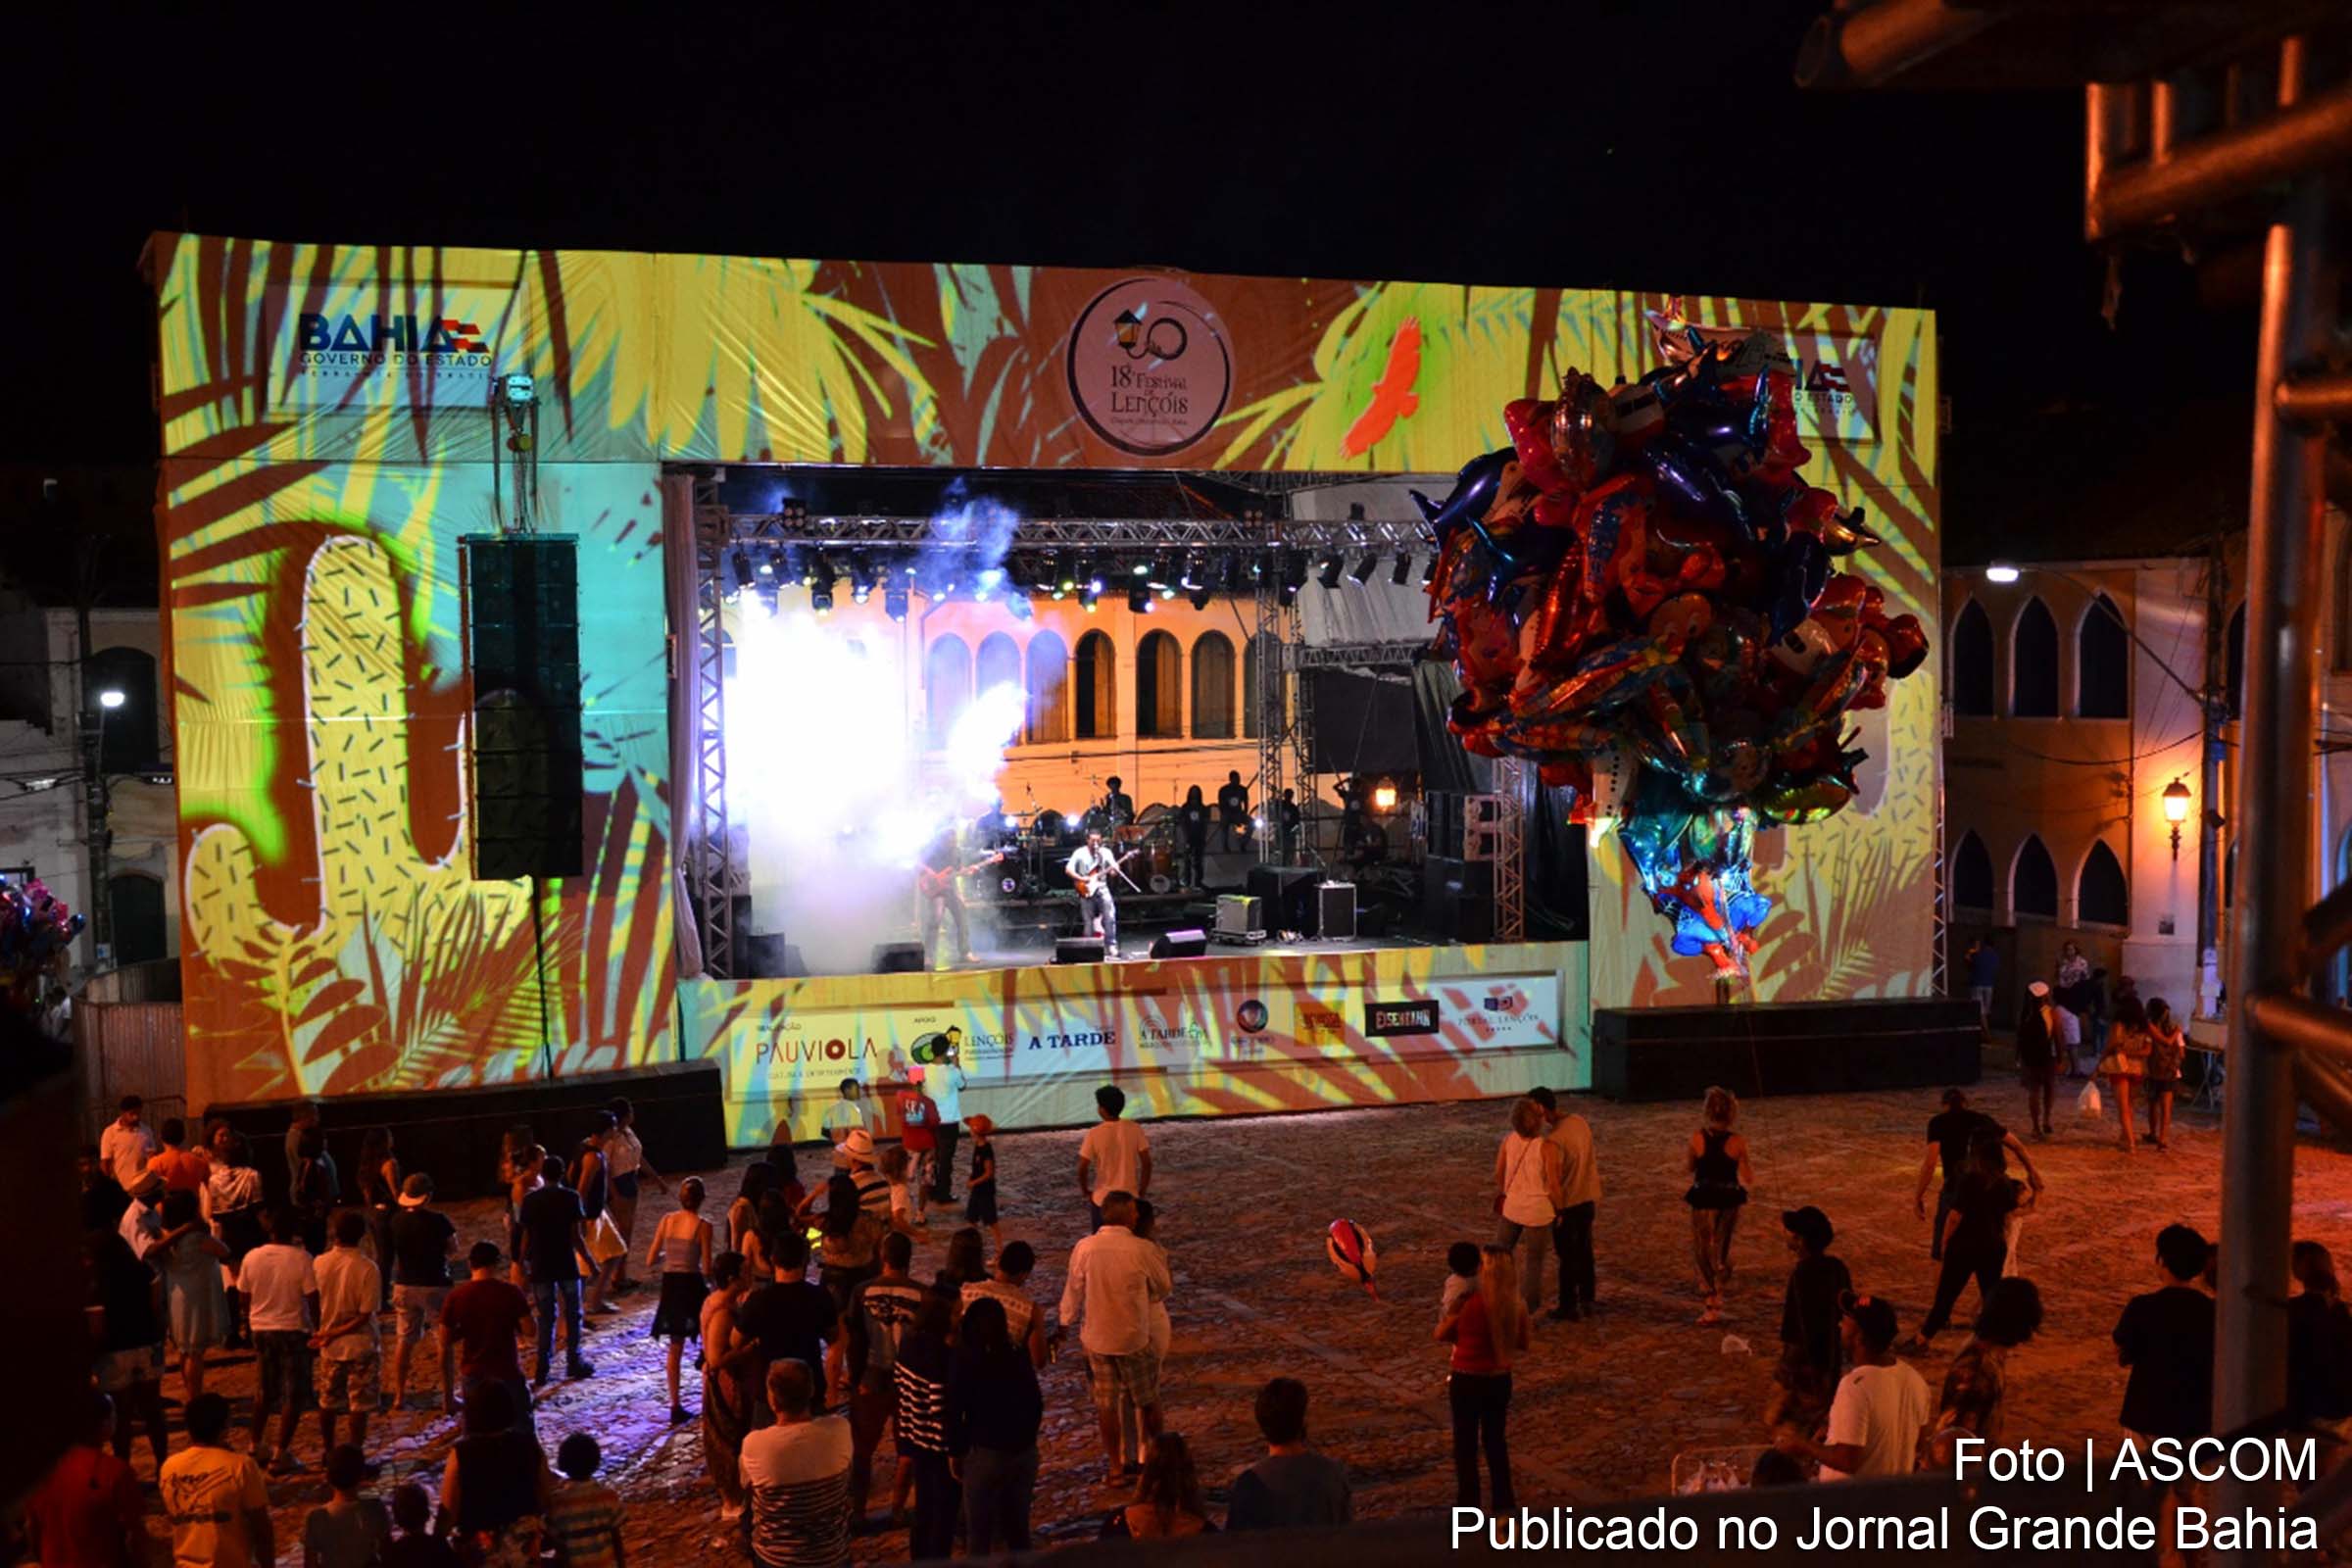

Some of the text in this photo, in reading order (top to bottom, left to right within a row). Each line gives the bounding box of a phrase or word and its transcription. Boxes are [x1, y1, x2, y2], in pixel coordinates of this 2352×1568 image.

[299, 315, 459, 353] BAHIA
[300, 352, 492, 367] GOVERNO DO ESTADO
[756, 1037, 878, 1064] PAUVIOLA
[1029, 1031, 1116, 1050] A TARDE
